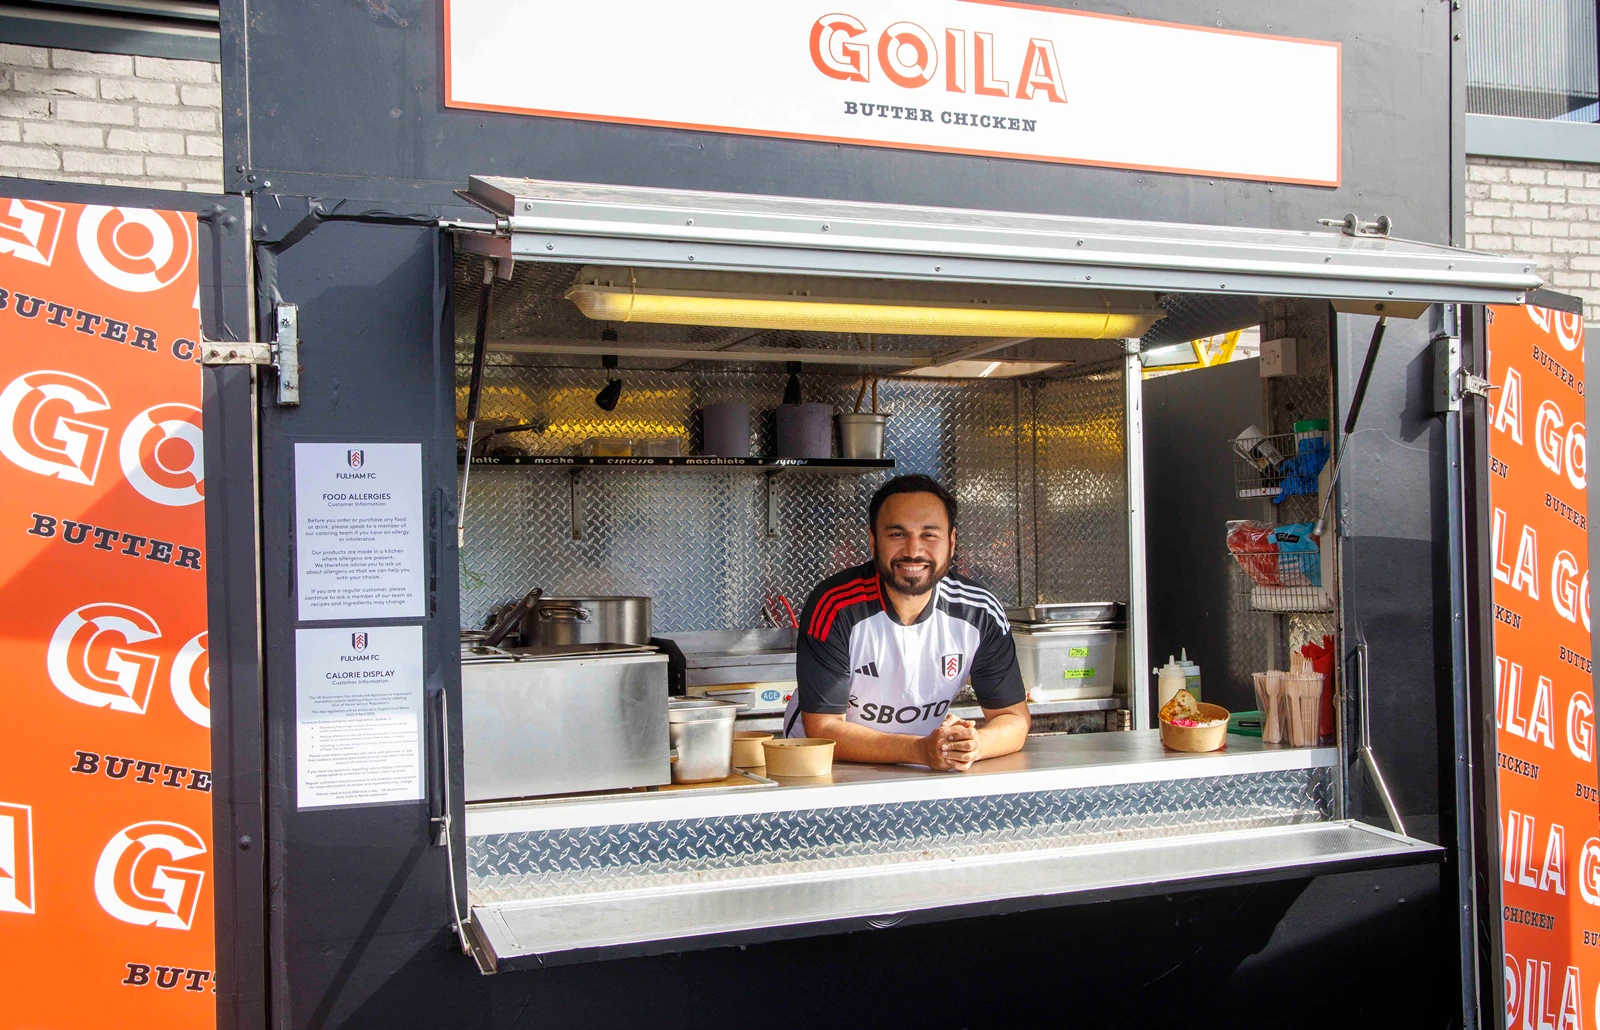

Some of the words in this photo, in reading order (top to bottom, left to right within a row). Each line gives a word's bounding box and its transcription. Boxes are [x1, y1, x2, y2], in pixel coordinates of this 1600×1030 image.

[808, 12, 1068, 104] GOILA
[843, 100, 934, 123] BUTTER
[940, 110, 1038, 133] CHICKEN
[172, 338, 202, 365] C
[1532, 344, 1575, 390] BUTTER
[686, 457, 746, 465] macchiato
[1489, 454, 1508, 479] EN
[1545, 493, 1587, 530] BUTTER
[27, 512, 201, 571] BUTTER
[326, 672, 361, 680] CALORIE
[363, 670, 394, 679] DISPLAY
[763, 691, 778, 700] ACE
[1503, 905, 1556, 930] CHICKEN
[122, 962, 217, 993] BUT
